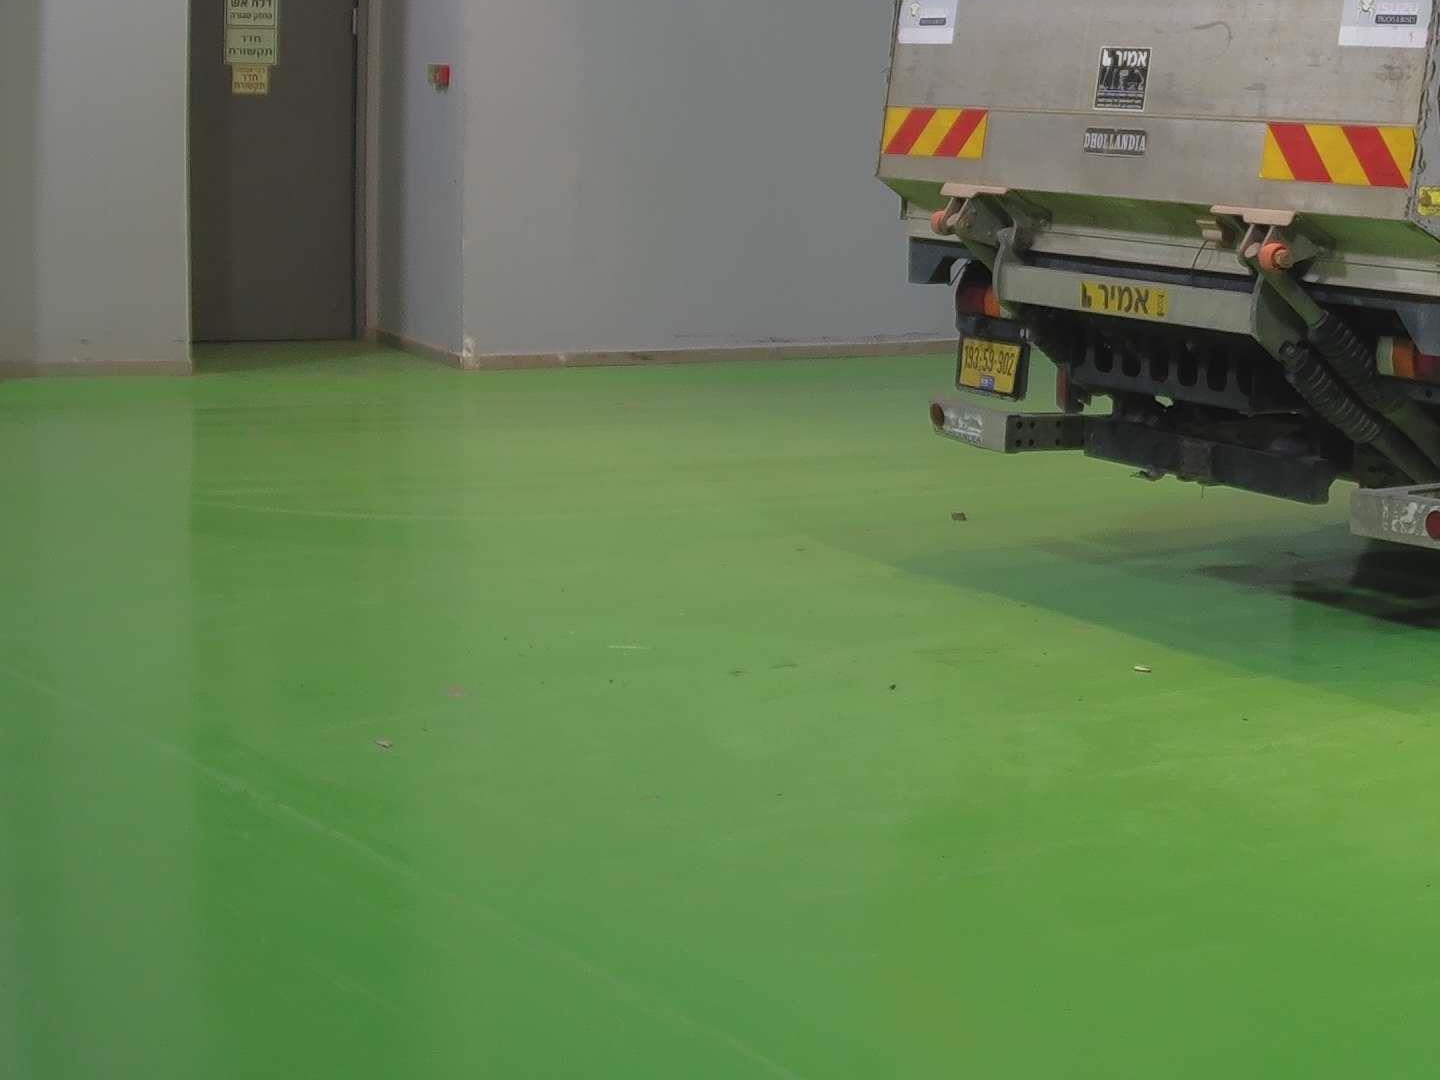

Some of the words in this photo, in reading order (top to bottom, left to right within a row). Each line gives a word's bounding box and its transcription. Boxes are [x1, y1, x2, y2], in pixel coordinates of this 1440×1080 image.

[231, 0, 248, 8] אש
[242, 35, 262, 43] חדר
[229, 48, 273, 59] תקשורת
[1116, 50, 1147, 67] אמיר
[1083, 133, 1146, 152] DHOLLANDIA
[1097, 284, 1149, 314] אמיר
